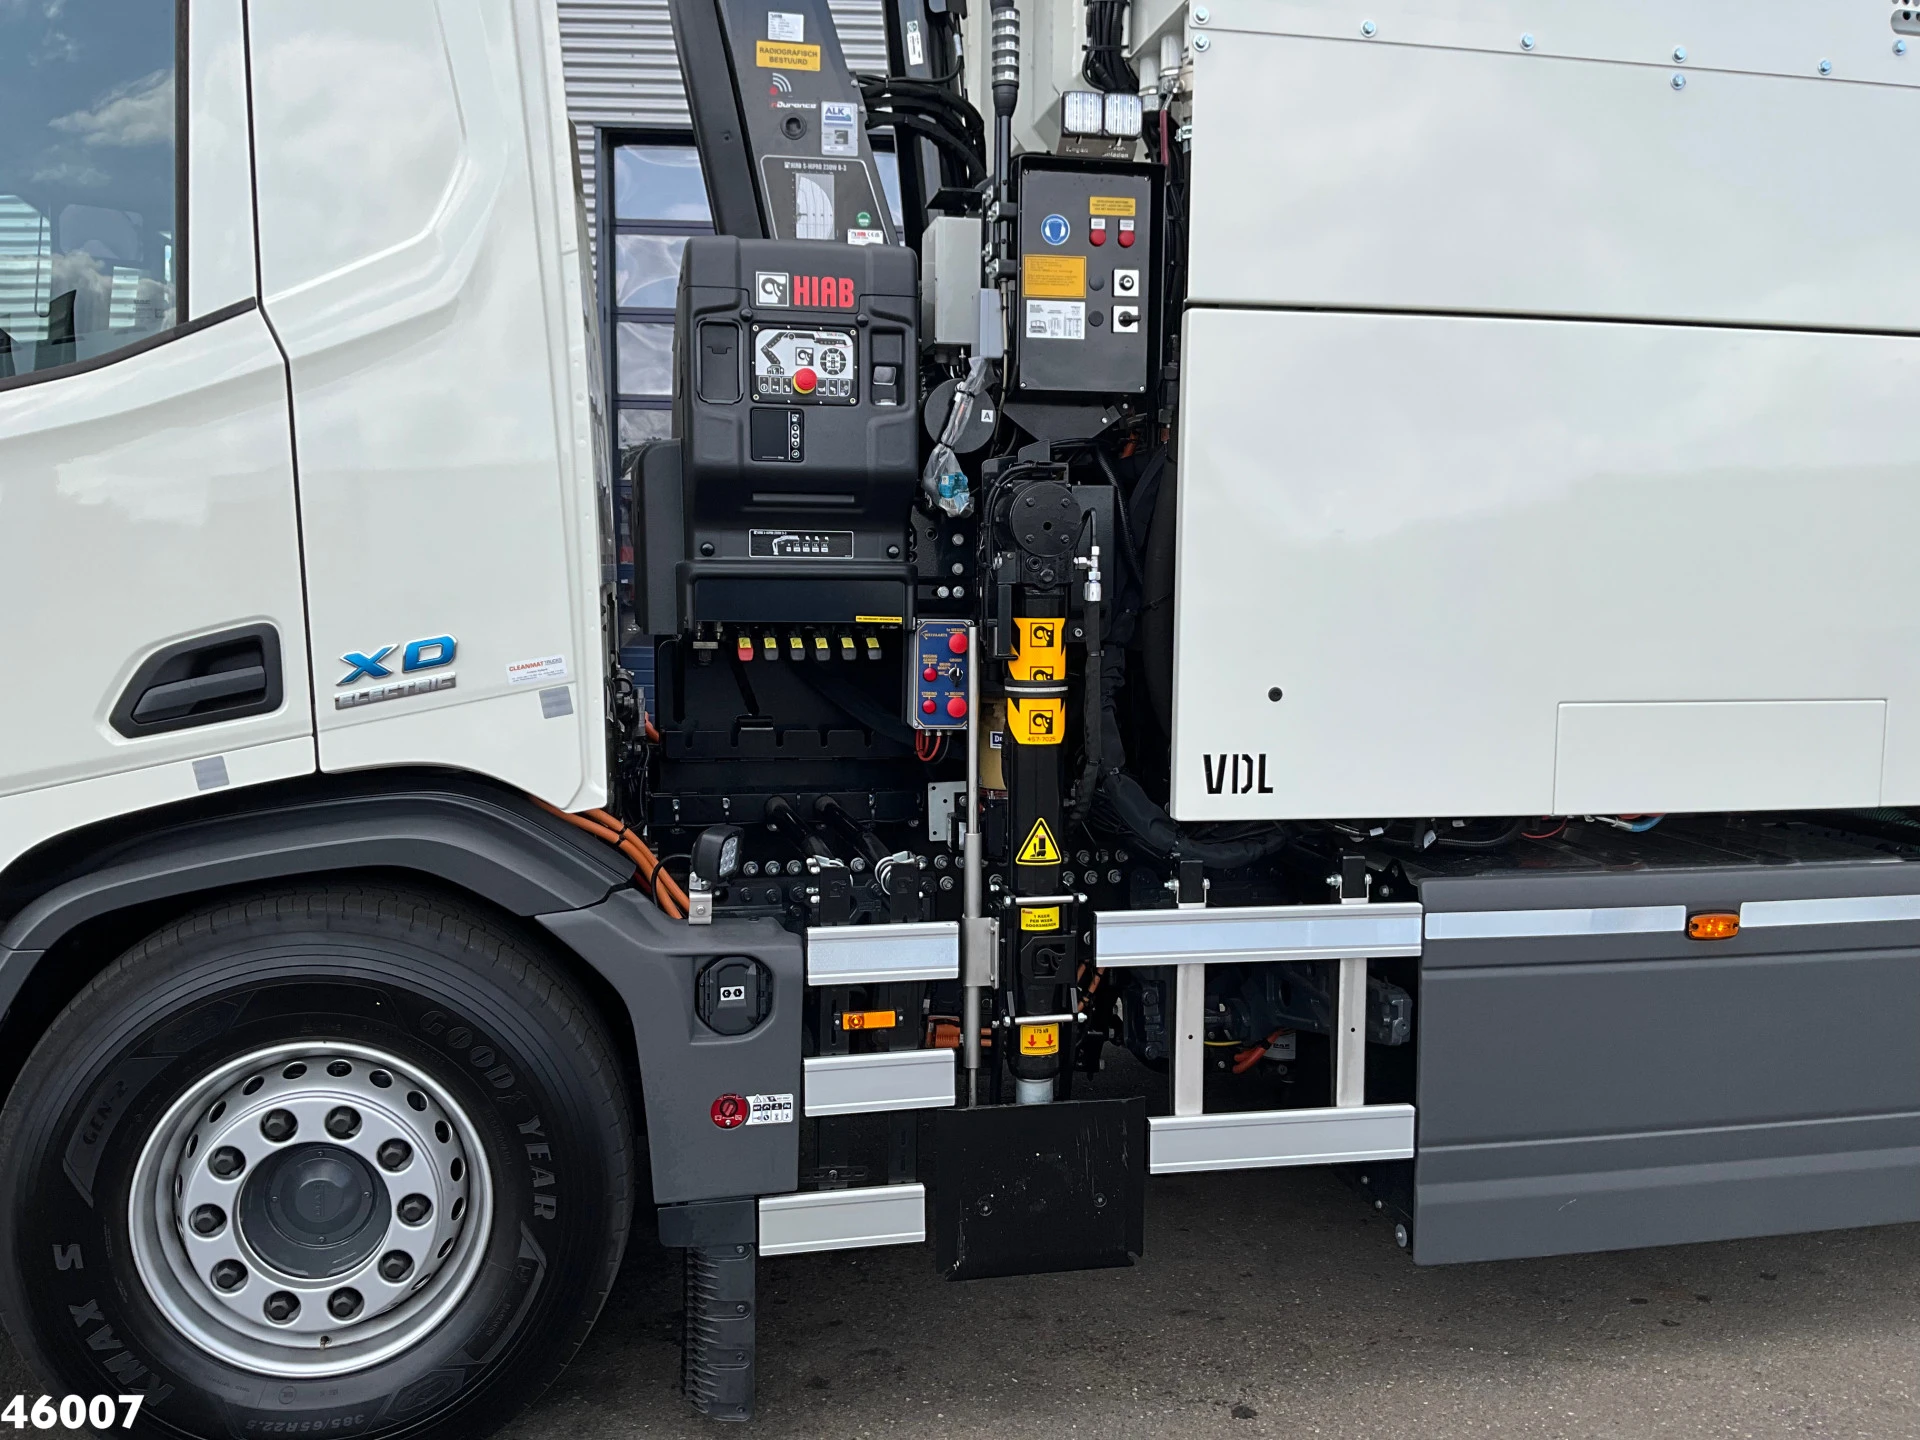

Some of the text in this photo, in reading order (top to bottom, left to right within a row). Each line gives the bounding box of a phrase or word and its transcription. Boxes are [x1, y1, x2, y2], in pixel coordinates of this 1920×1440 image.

[759, 47, 818, 57] RADIOGRAFISCH
[769, 57, 808, 65] BESTUURD
[825, 107, 844, 115] ALK
[793, 275, 855, 308] HIAB
[983, 412, 991, 420] A
[336, 633, 458, 687] XD
[508, 661, 544, 672] CLEANMAT
[338, 672, 457, 709] ELECTRIC
[1202, 753, 1274, 794] VDL
[82, 1080, 129, 1145] GEN-2
[419, 1010, 516, 1089] GOOD
[516, 1114, 558, 1220] YEAR
[52, 1243, 176, 1407] KMAX S
[245, 1413, 365, 1433] 385/65R22.5
